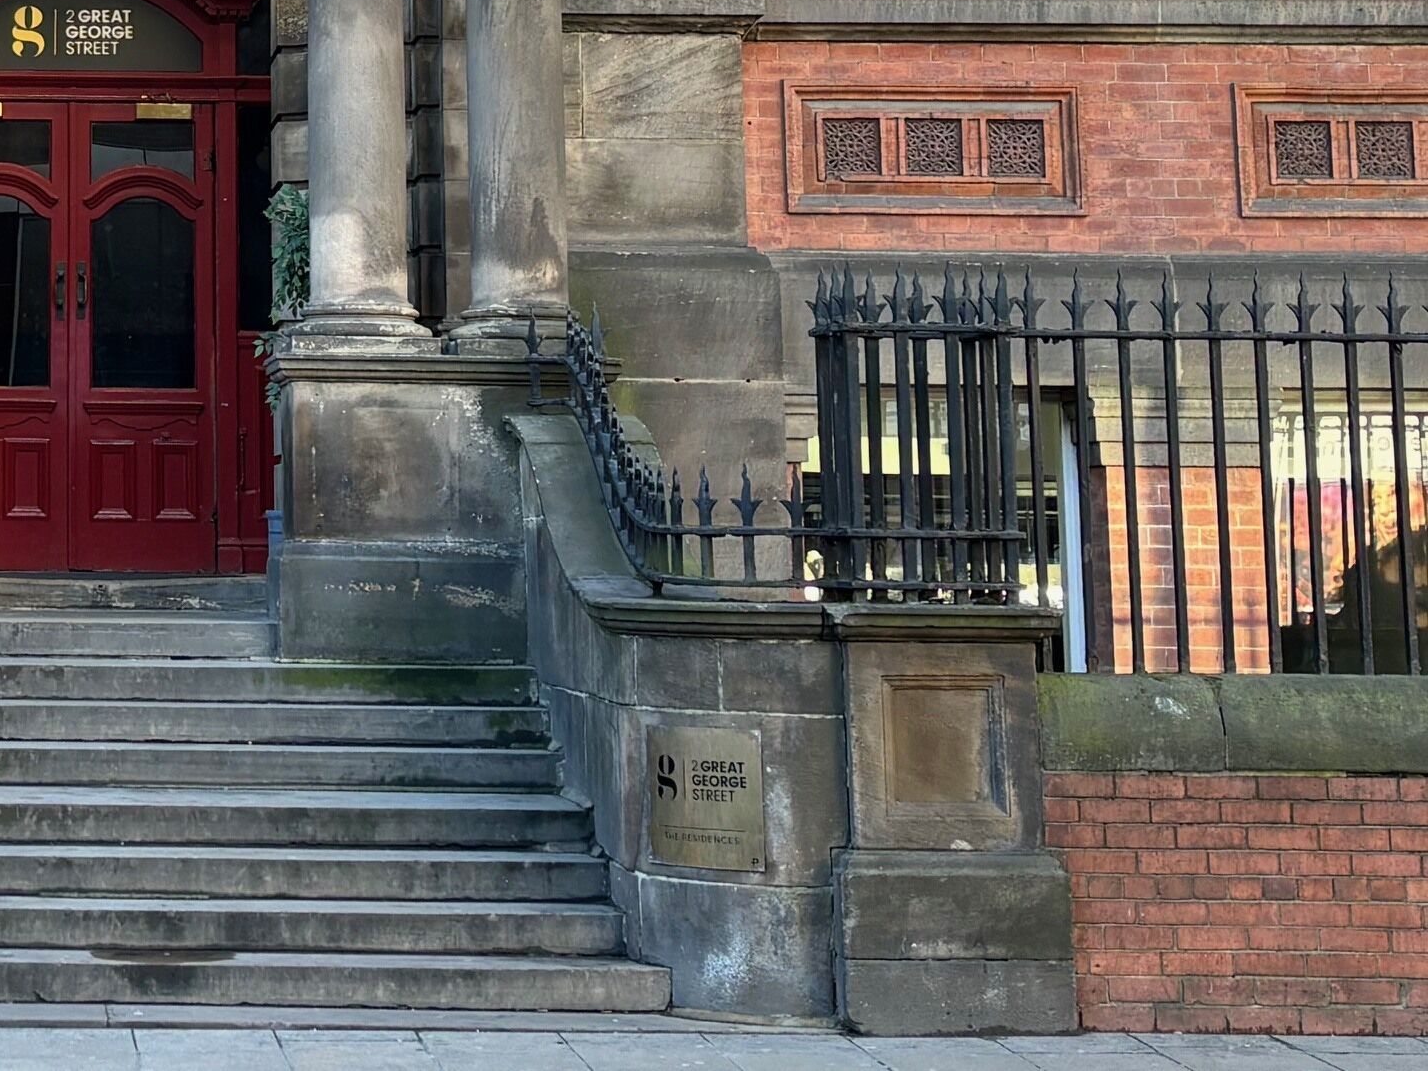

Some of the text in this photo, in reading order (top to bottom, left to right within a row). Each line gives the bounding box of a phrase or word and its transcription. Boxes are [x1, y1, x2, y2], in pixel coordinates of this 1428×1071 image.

[66, 9, 132, 23] 2 GREAT
[65, 25, 134, 39] GEORGE
[65, 41, 119, 55] STREET
[691, 760, 745, 774] 2 GREAT
[692, 774, 747, 789] GEORGE
[692, 789, 736, 802] STREET
[664, 831, 740, 845] THE RESIDENCES
